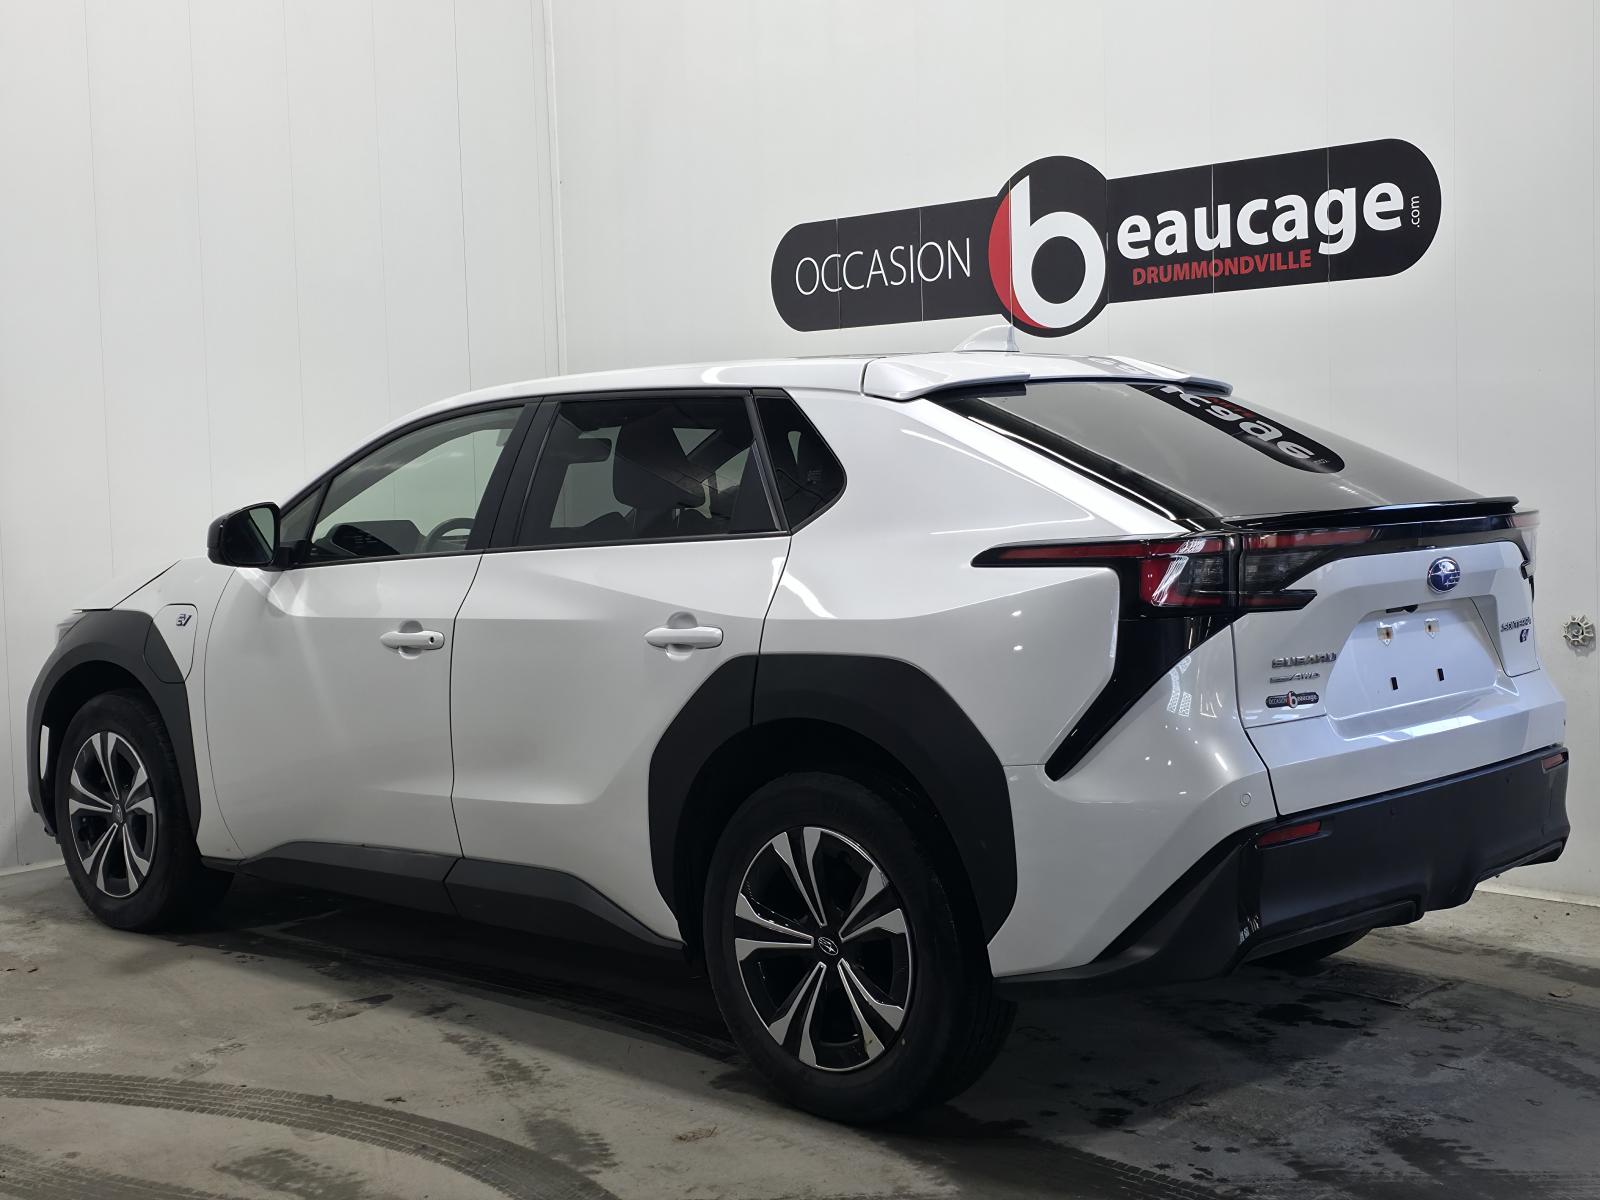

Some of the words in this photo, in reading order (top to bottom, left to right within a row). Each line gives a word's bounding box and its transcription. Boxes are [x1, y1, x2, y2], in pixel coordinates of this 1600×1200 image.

[1410, 195, 1420, 228] .com
[796, 237, 971, 295] OCCASION
[1133, 249, 1312, 286] DRUMMONDVILLE
[1272, 652, 1337, 668] SUBARU
